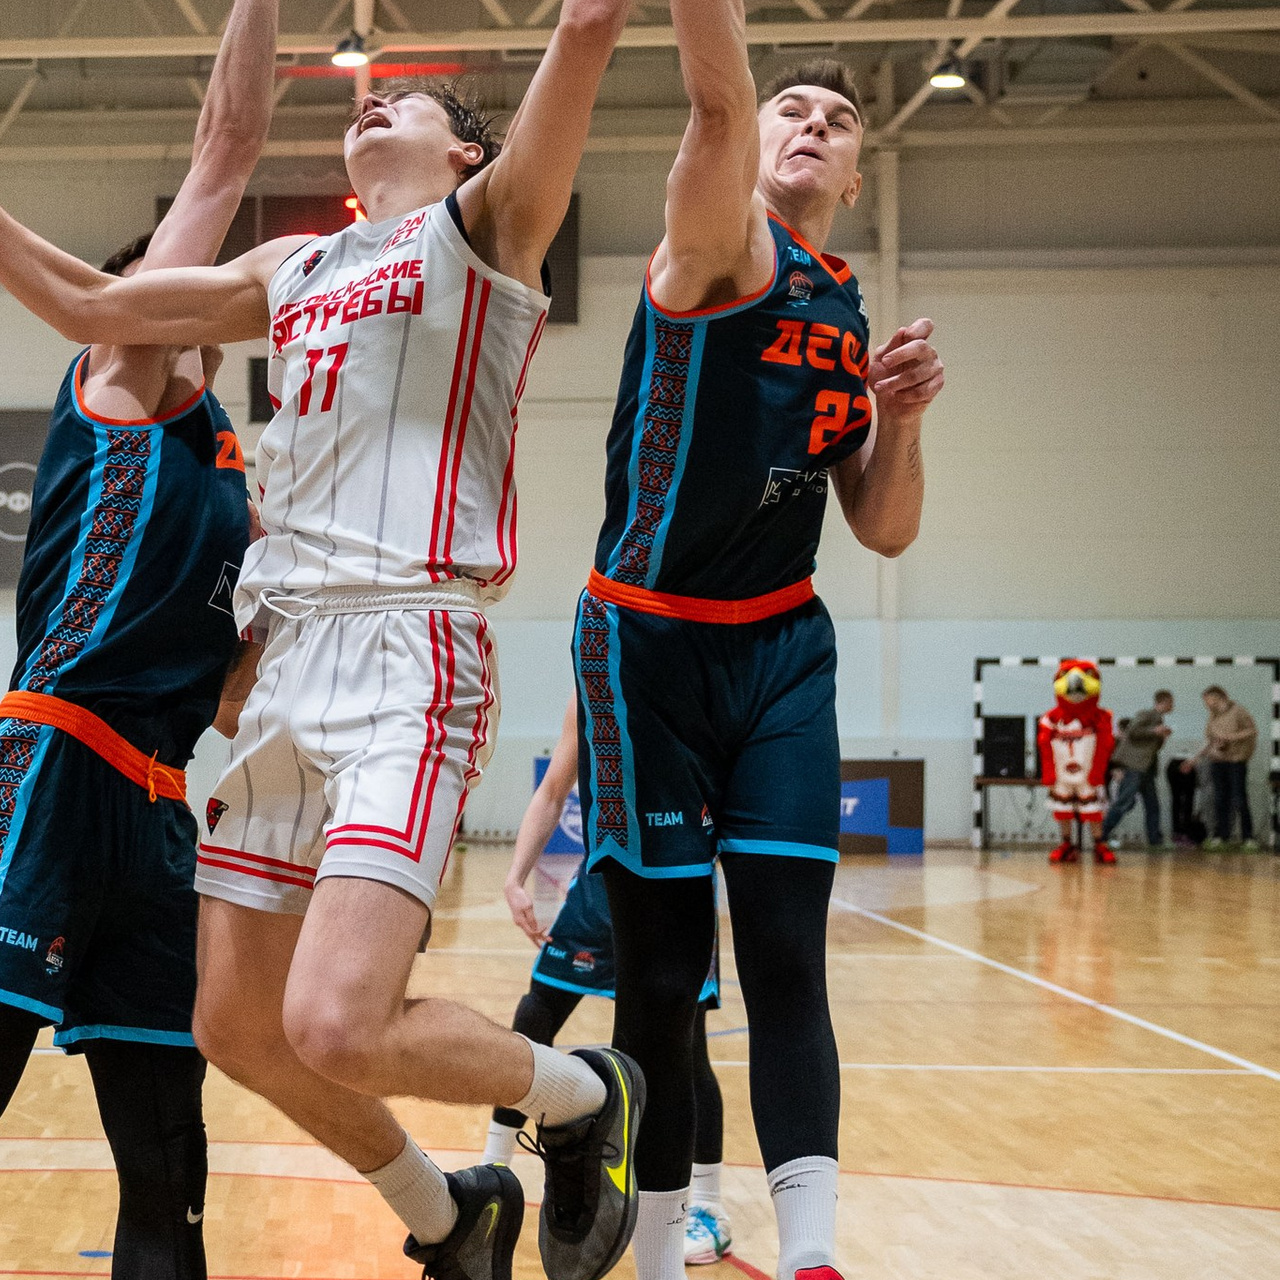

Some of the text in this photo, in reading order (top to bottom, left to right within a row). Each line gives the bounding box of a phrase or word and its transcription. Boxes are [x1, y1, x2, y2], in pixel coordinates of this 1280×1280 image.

[396, 211, 426, 233] ON
[788, 246, 811, 266] TEAM
[645, 811, 684, 826] TEAM
[0, 926, 39, 952] TEAM
